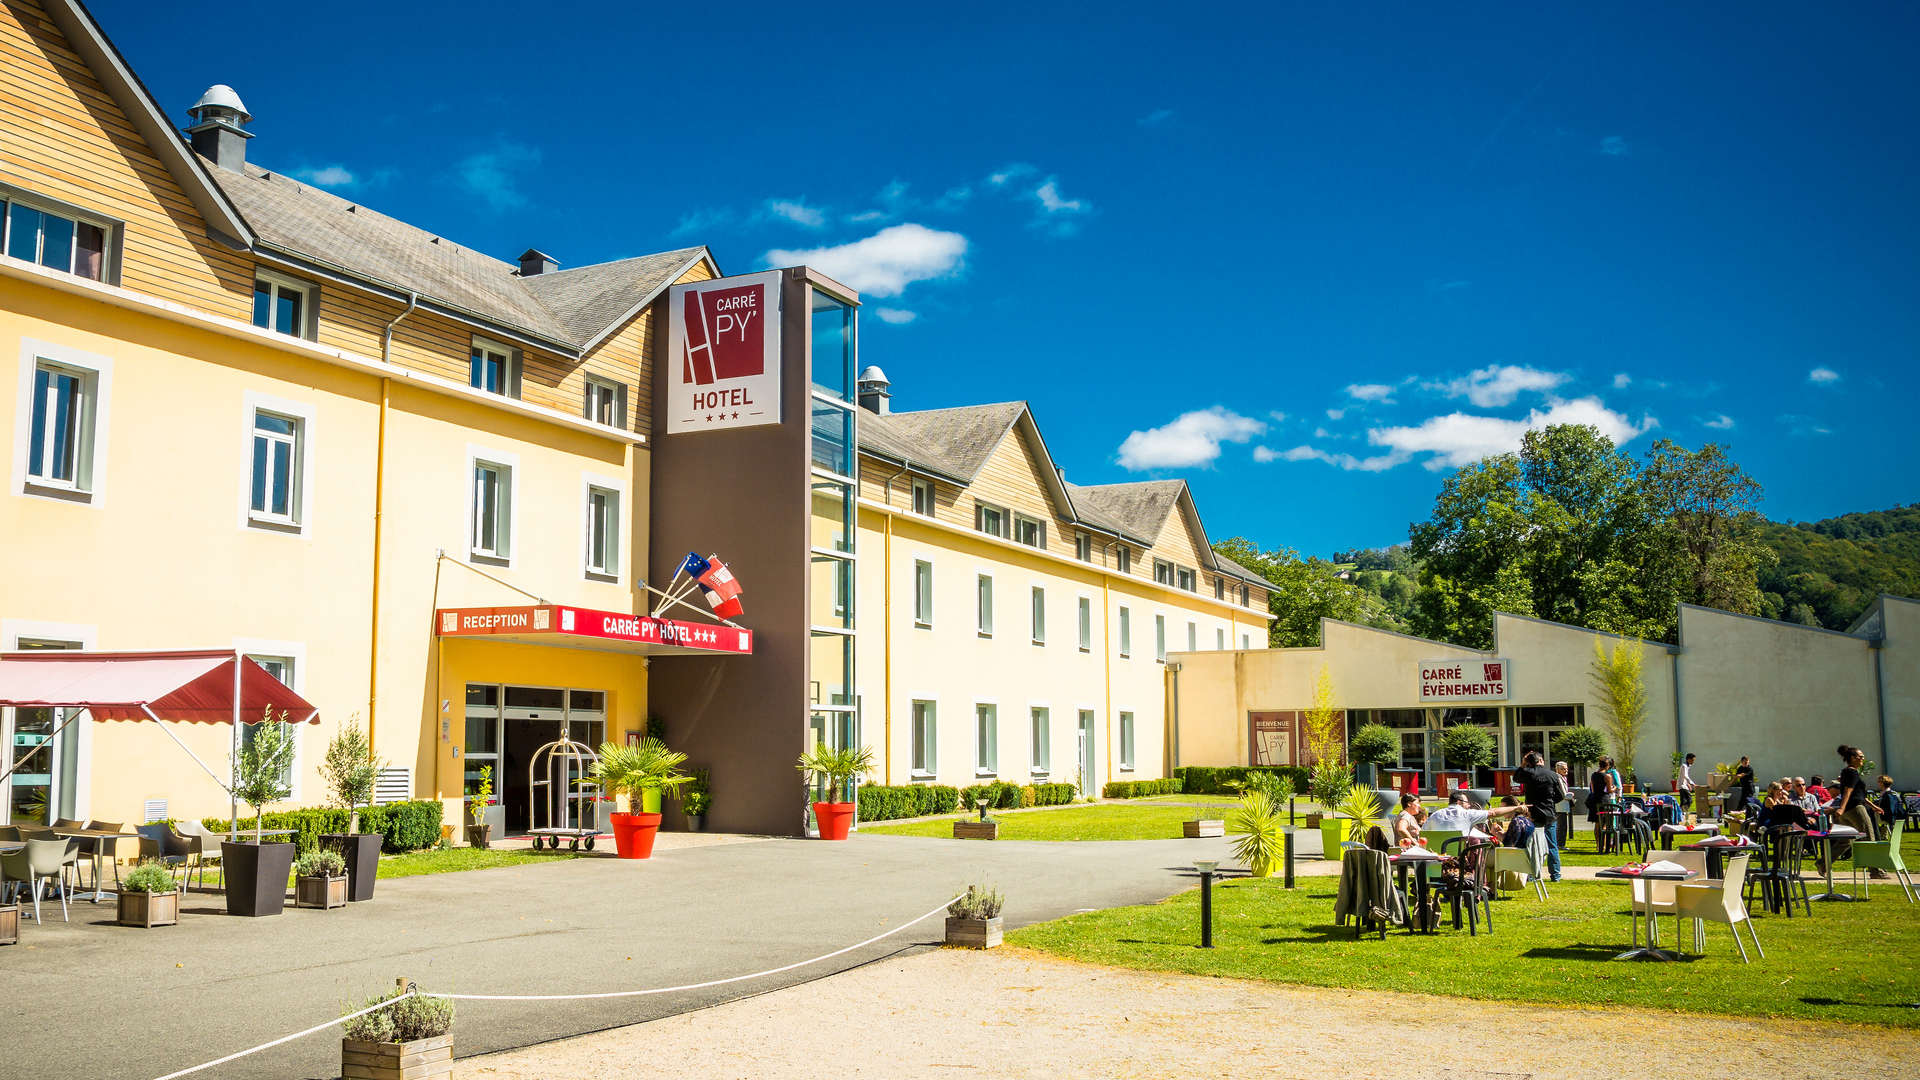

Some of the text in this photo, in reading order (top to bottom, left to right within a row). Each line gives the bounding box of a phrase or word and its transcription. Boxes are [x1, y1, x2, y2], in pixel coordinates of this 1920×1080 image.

[716, 291, 756, 311] CARRÉ
[716, 311, 757, 344] PY'
[693, 388, 753, 410] HOTEL
[463, 613, 528, 629] RECEPTION
[603, 616, 692, 643] CARRÉ PY' HÔTEL
[1422, 664, 1462, 680] CARRÉ
[1423, 681, 1504, 696] ÉVÈNEMENTS
